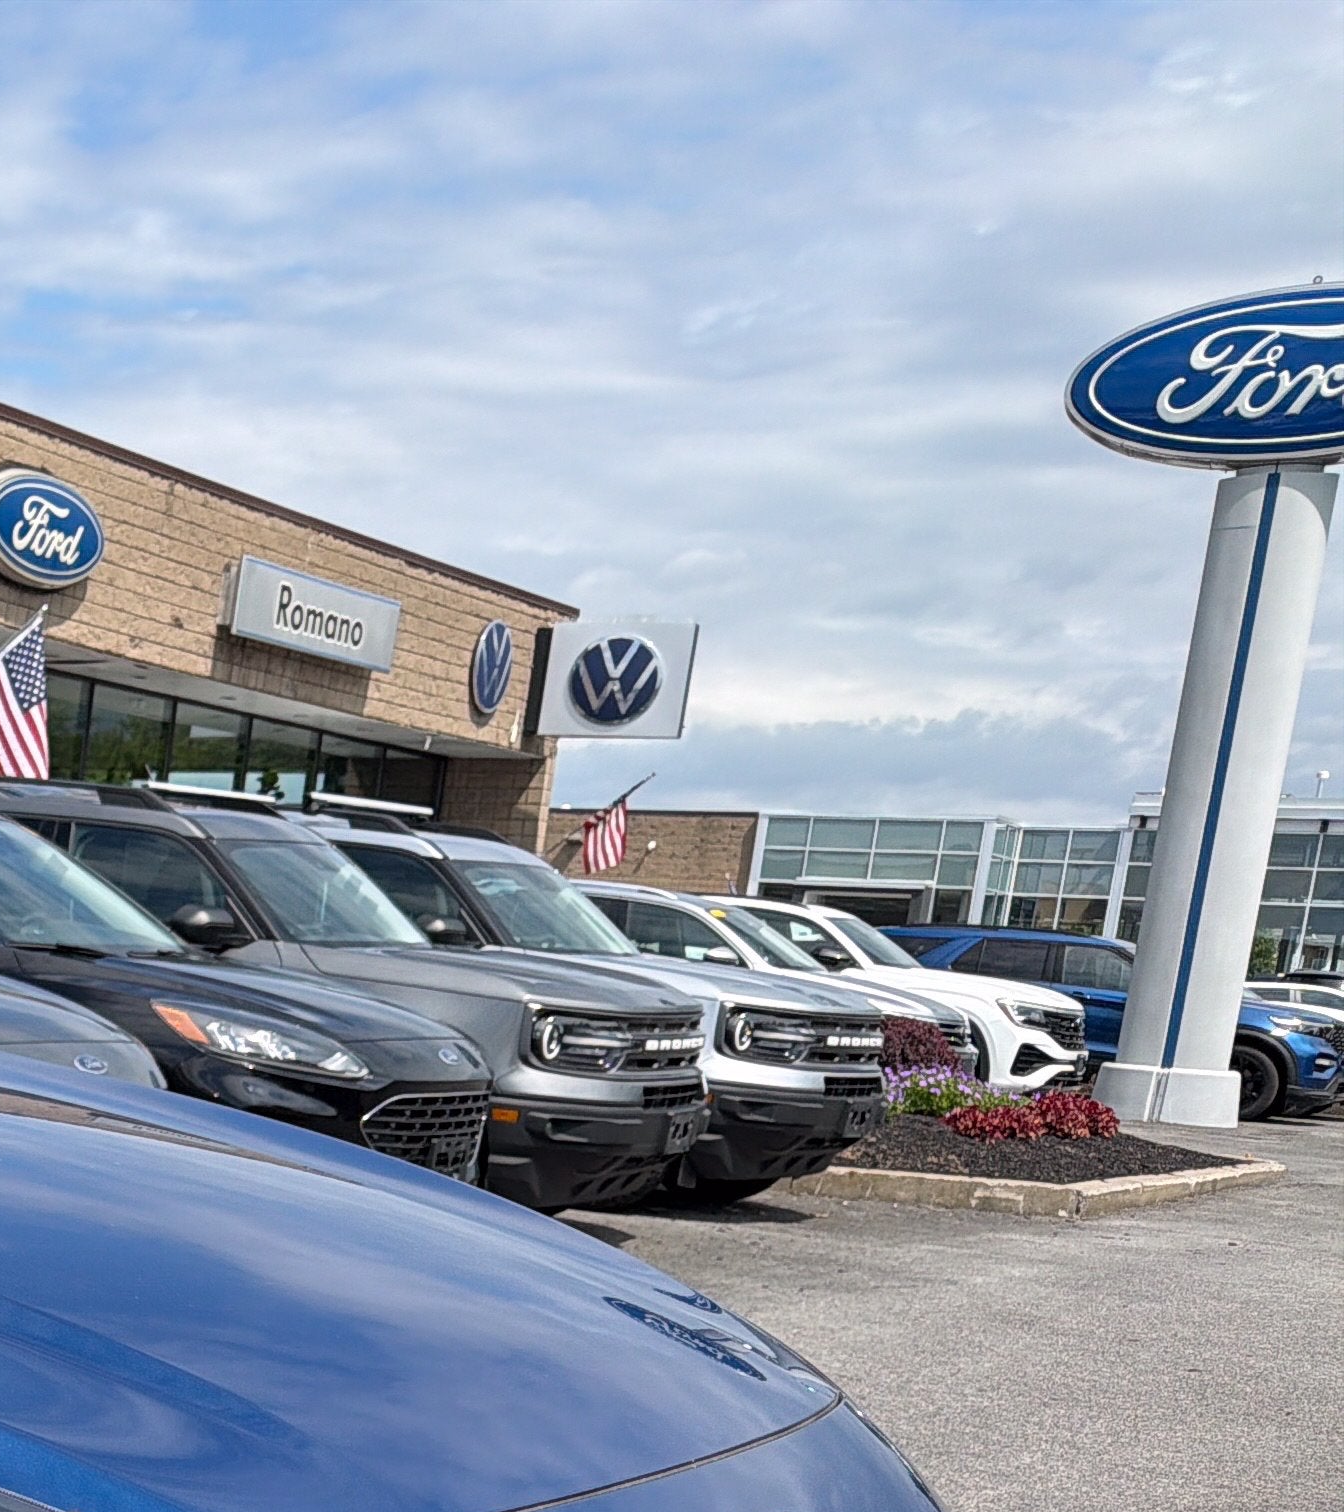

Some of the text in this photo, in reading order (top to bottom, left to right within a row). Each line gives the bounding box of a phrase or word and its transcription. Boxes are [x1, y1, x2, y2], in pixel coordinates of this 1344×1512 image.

[1156, 323, 1344, 425] For
[12, 494, 85, 566] Ford
[275, 583, 364, 647] Romano
